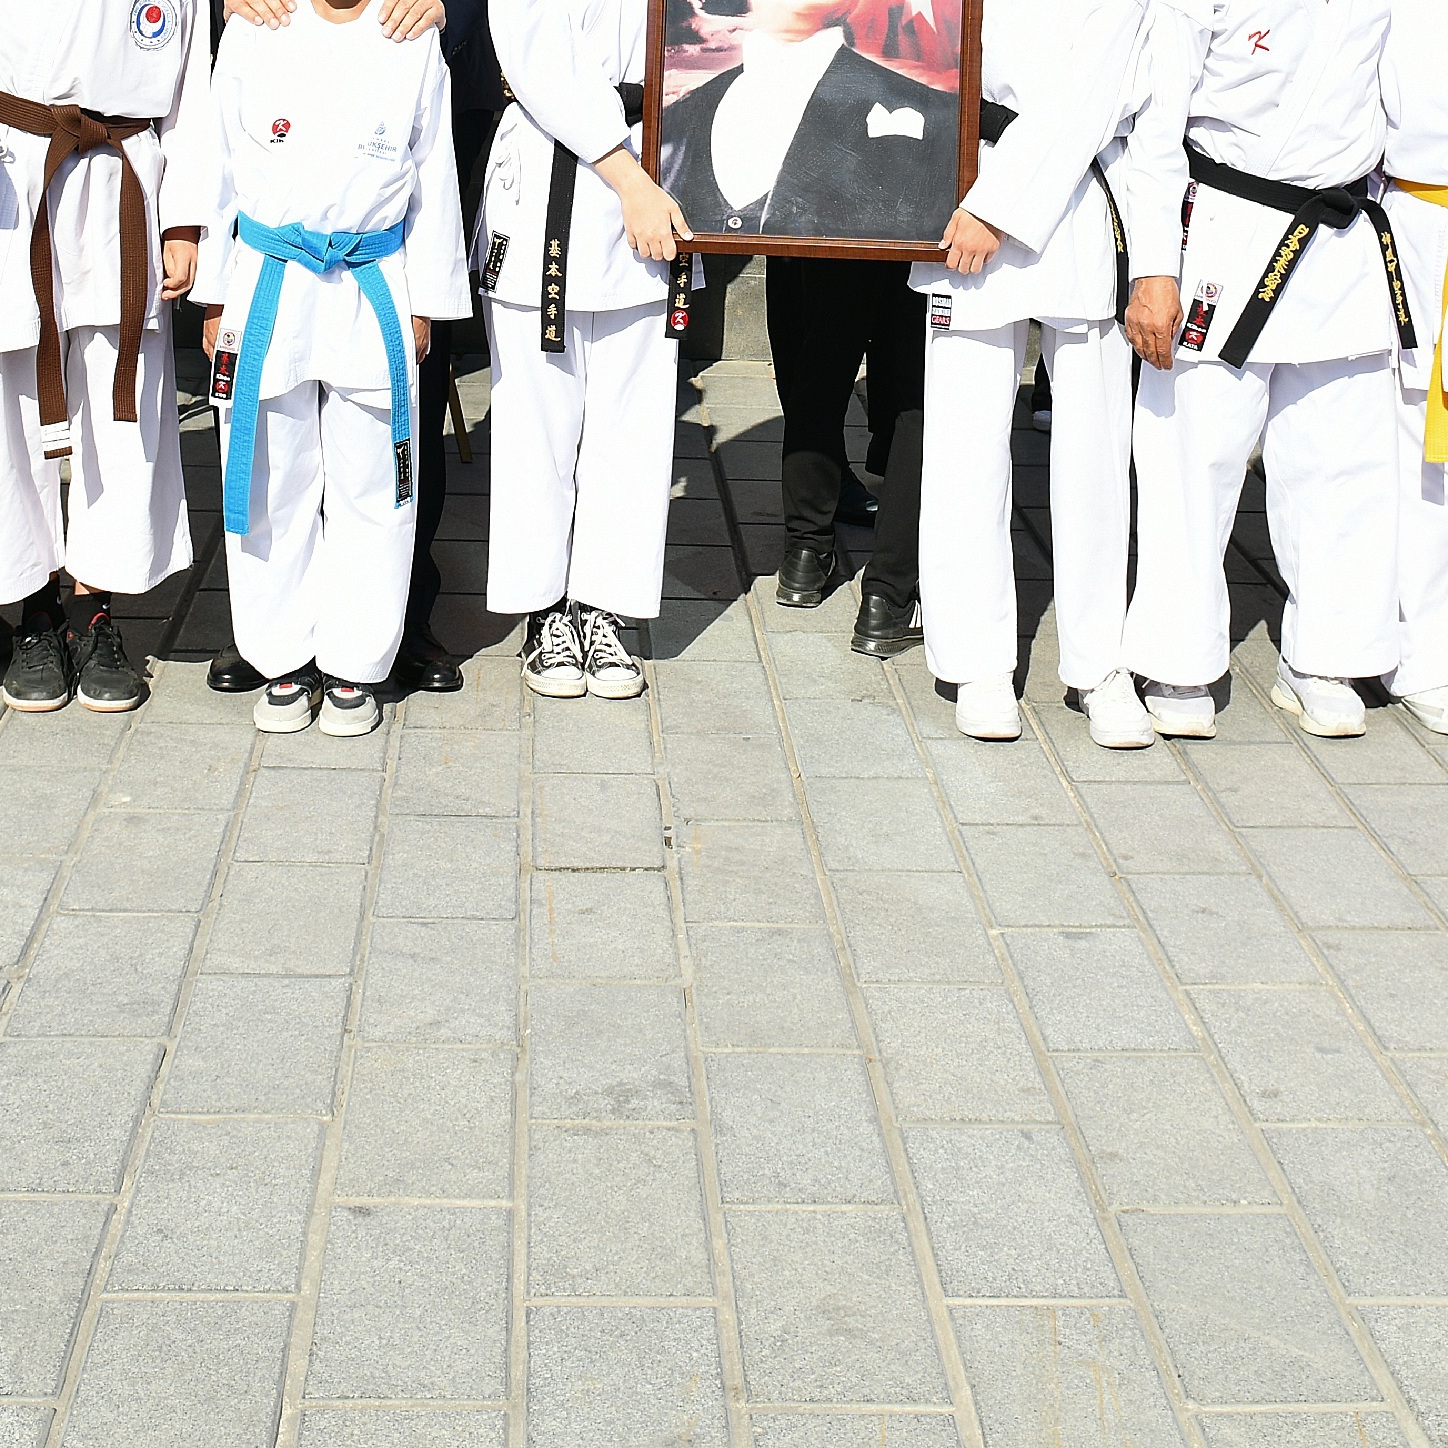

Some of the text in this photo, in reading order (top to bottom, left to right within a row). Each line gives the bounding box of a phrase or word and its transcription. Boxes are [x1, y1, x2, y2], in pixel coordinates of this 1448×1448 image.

[545, 238, 563, 342] 基本空手道
